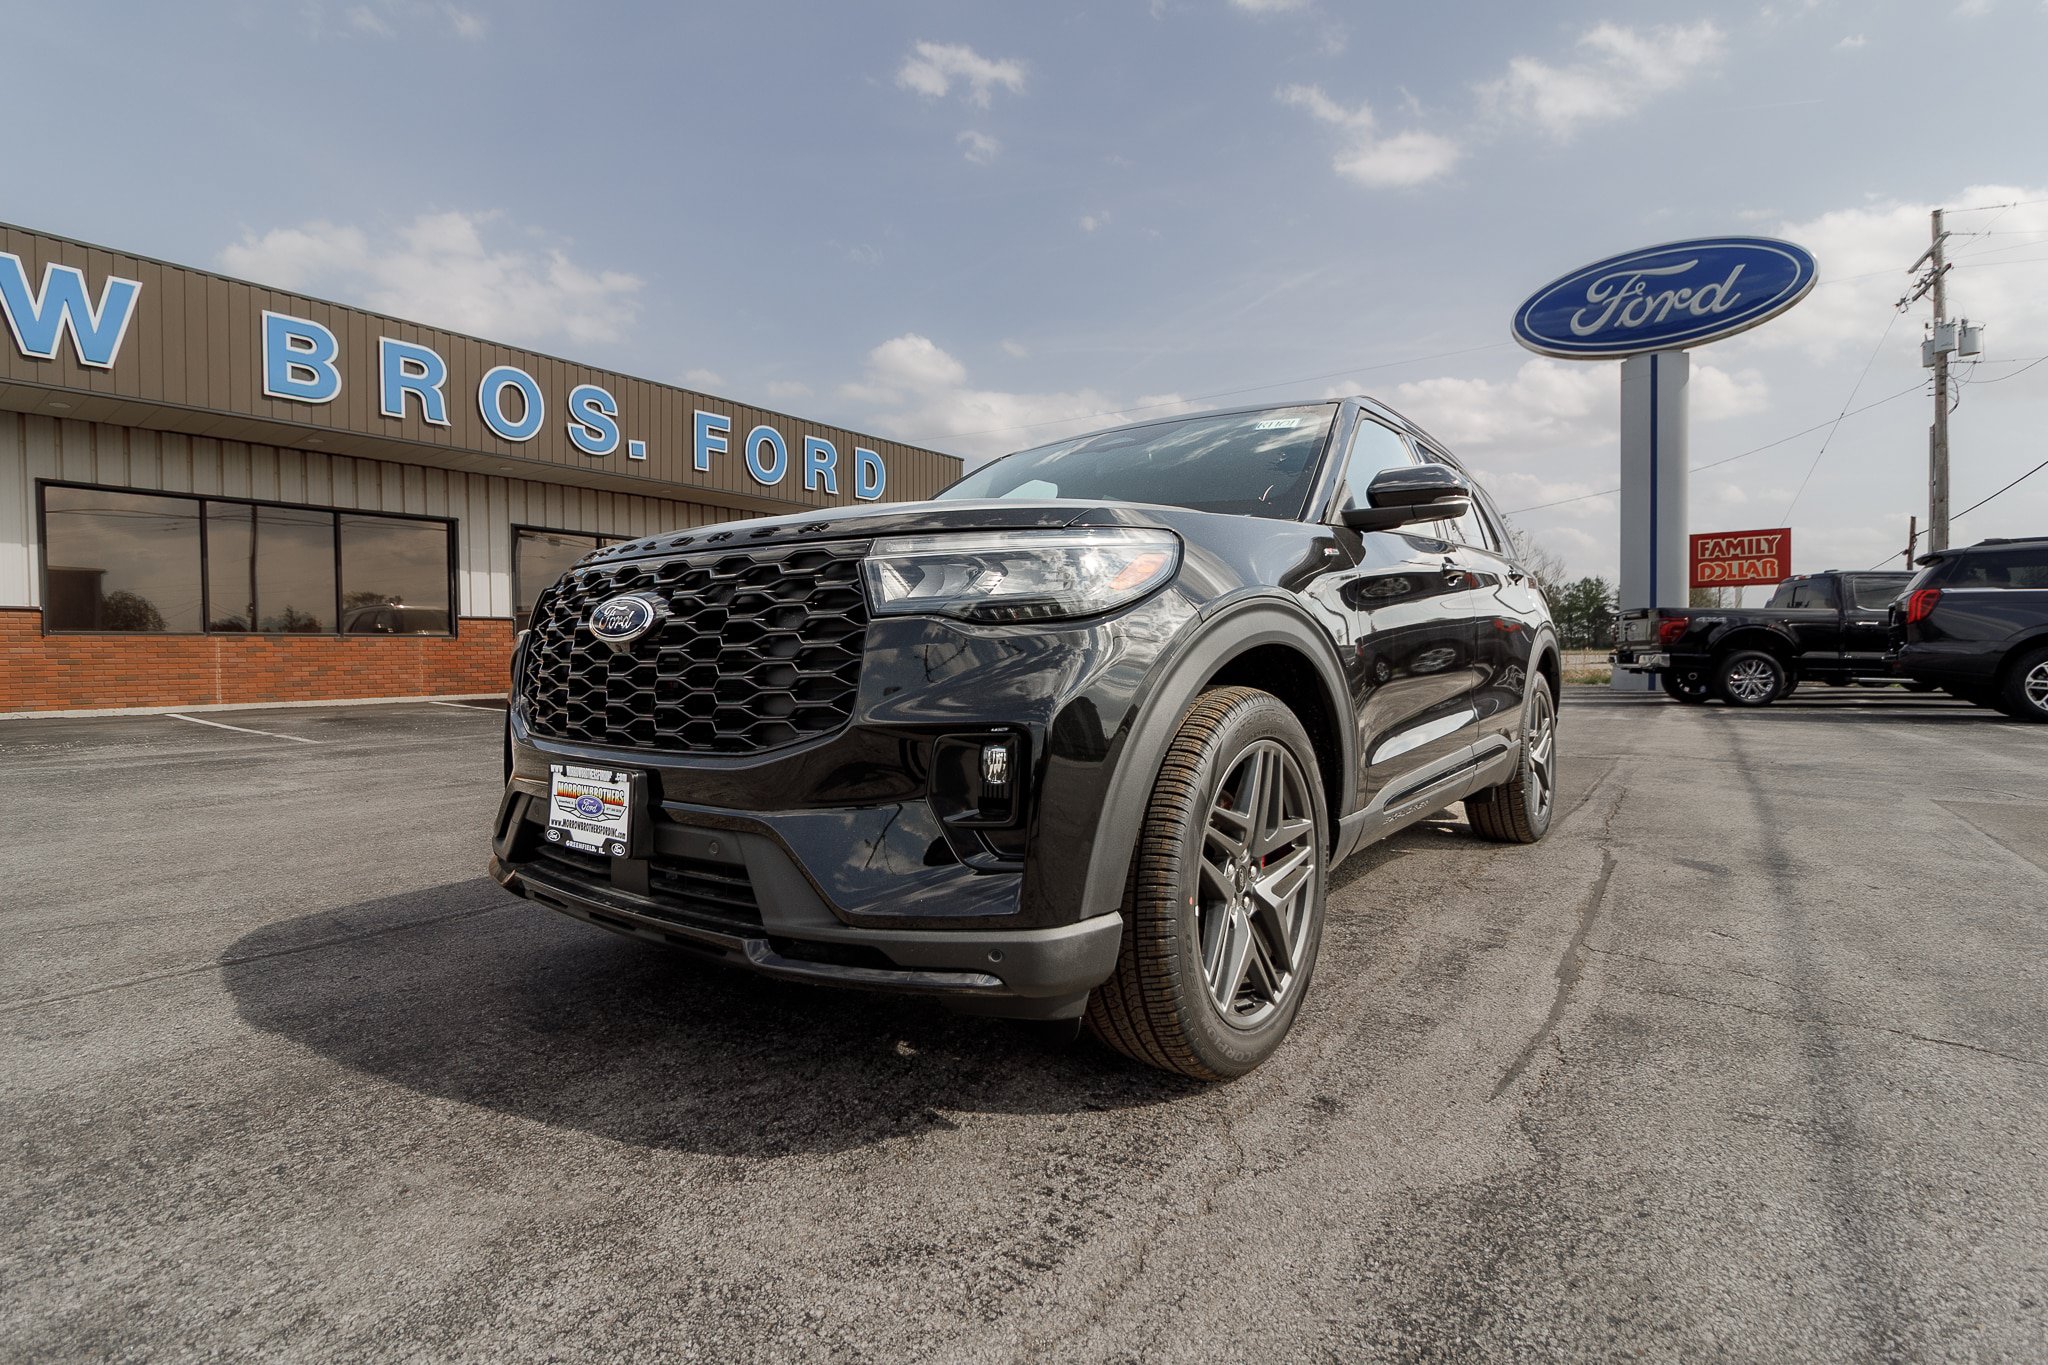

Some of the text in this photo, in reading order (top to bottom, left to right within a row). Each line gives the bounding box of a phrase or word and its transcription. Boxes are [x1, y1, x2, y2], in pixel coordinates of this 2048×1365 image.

[1570, 259, 1746, 336] Ford
[262, 309, 646, 461] BROS.
[694, 409, 886, 500] FORD
[1698, 534, 1782, 559] FAMILY
[1697, 559, 1778, 582] DOLLAR
[599, 606, 635, 630] Ford
[581, 798, 598, 813] Ford
